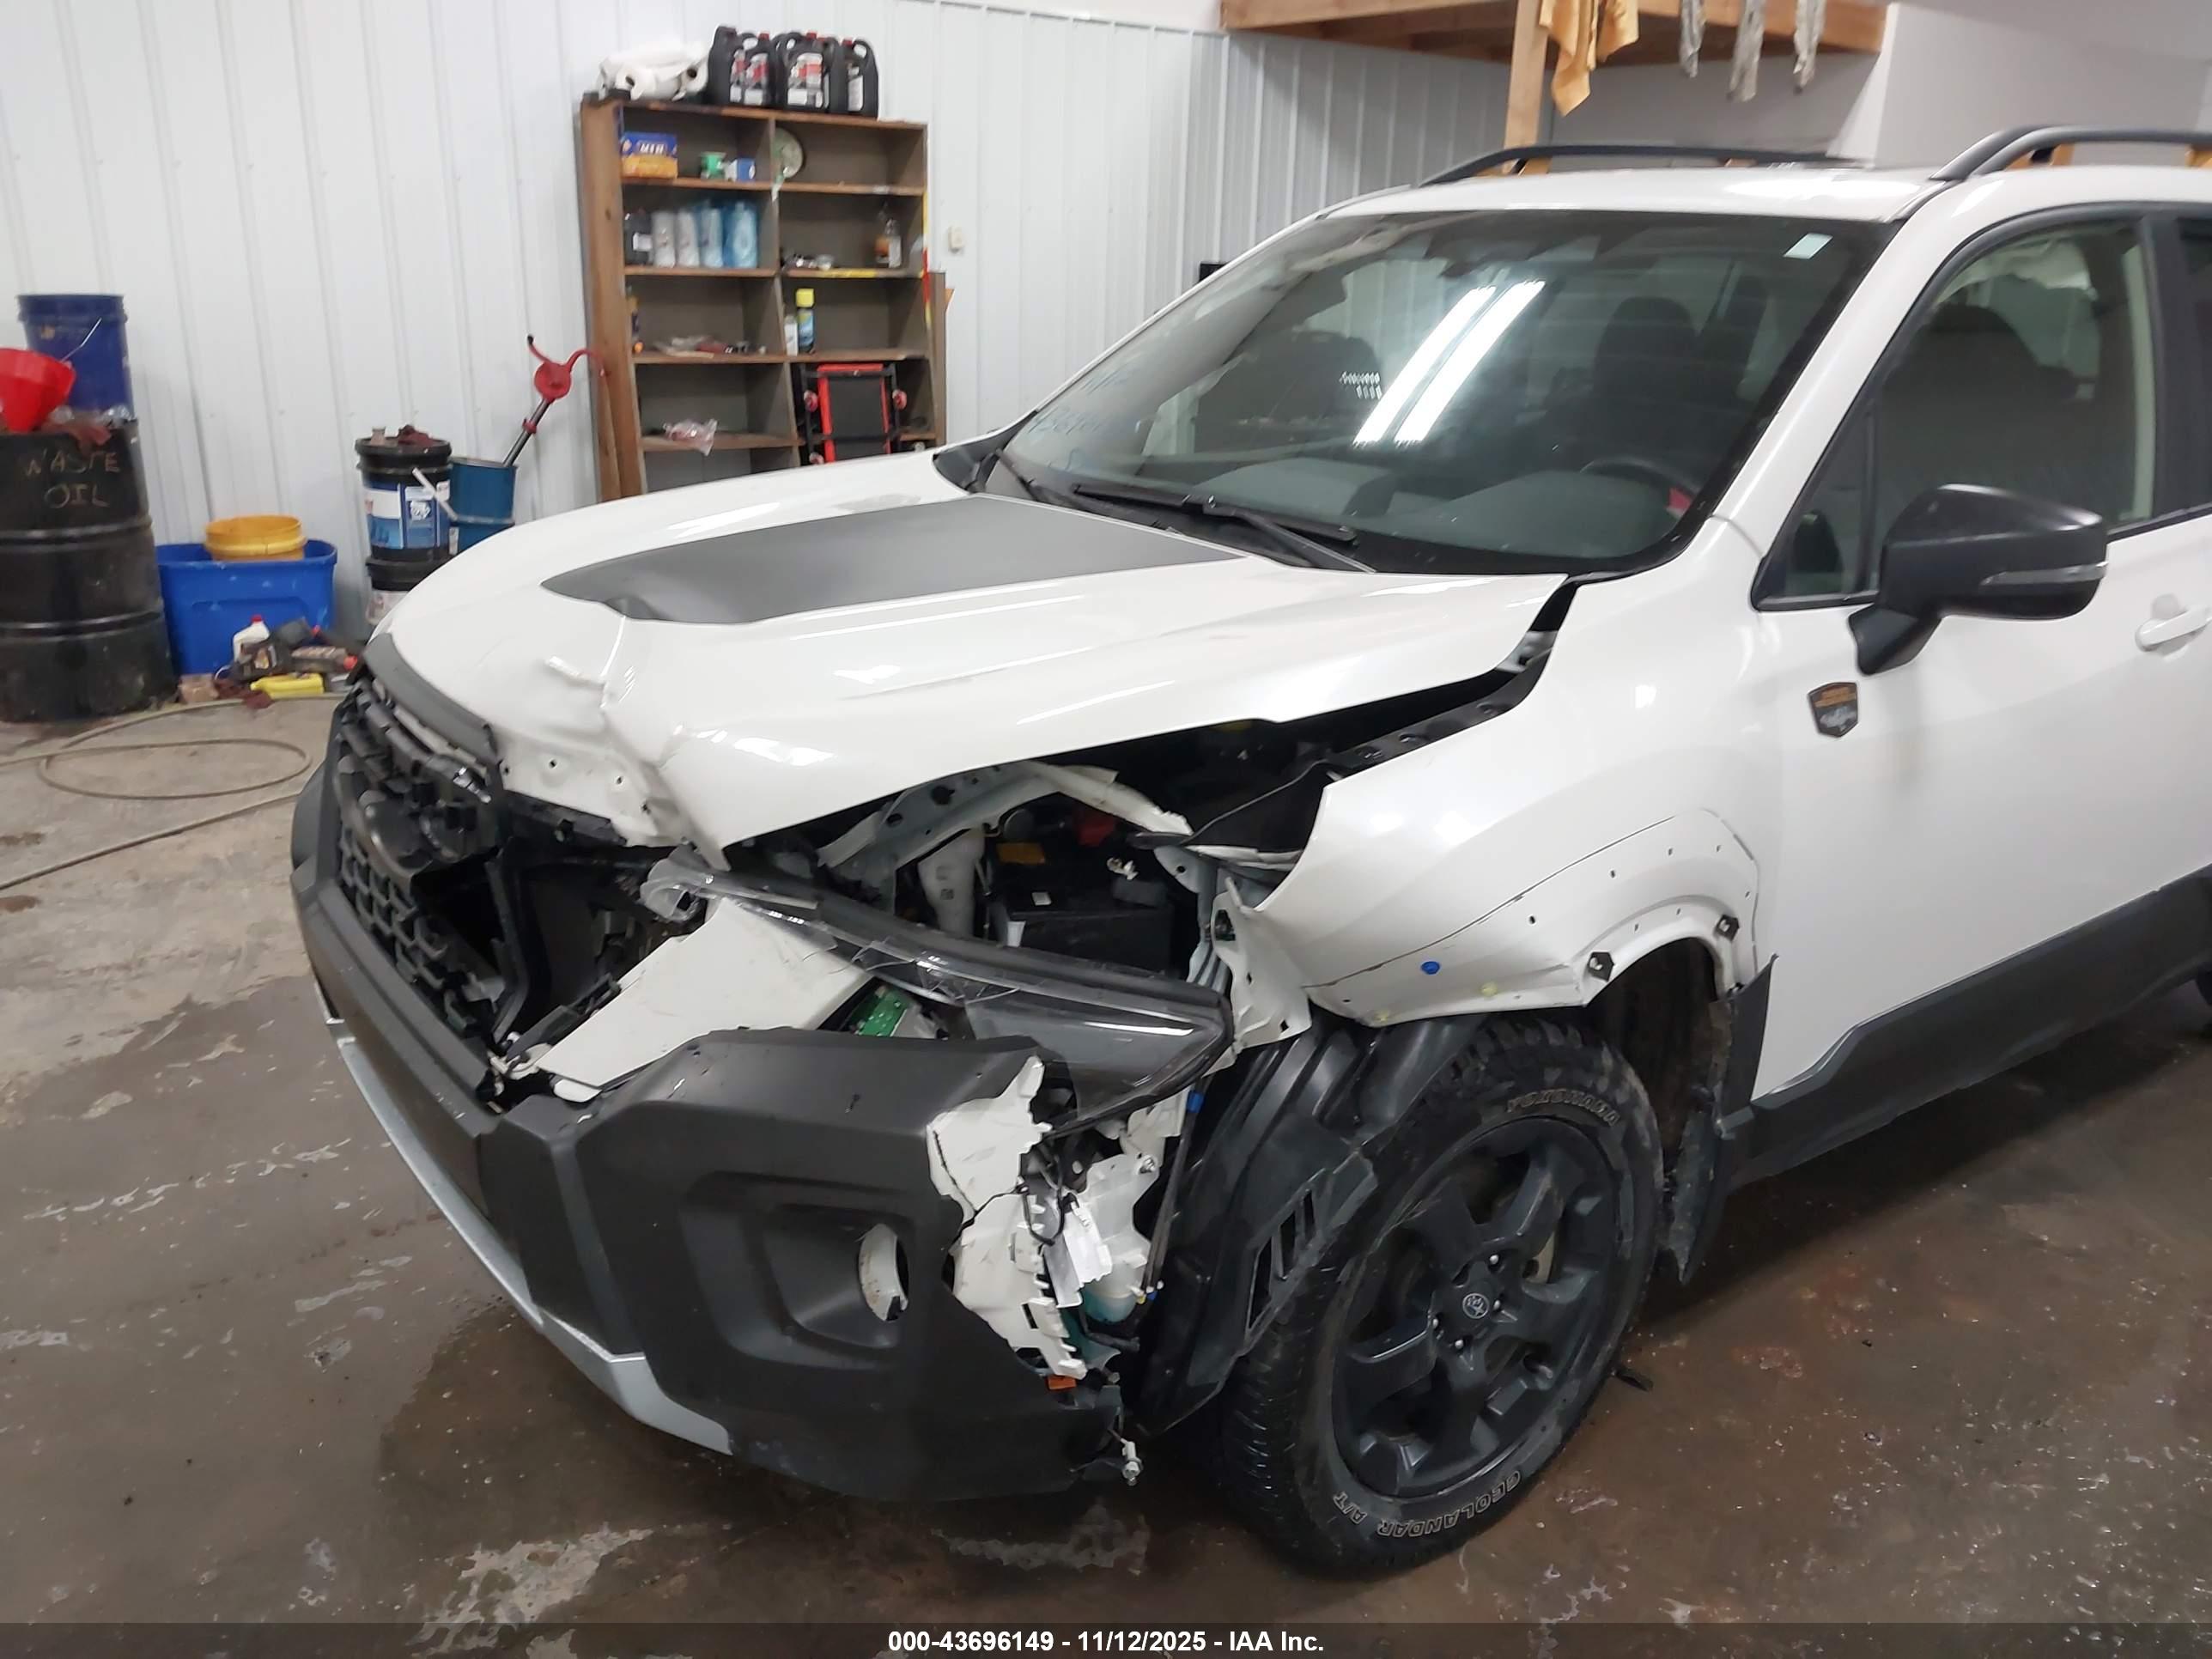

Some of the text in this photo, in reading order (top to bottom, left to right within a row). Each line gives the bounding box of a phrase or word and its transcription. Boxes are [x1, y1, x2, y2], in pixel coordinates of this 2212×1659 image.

[19, 447, 121, 477] WASTE
[43, 483, 110, 509] OIL
[1332, 1470, 1522, 1538] GEOLANDAR A/T
